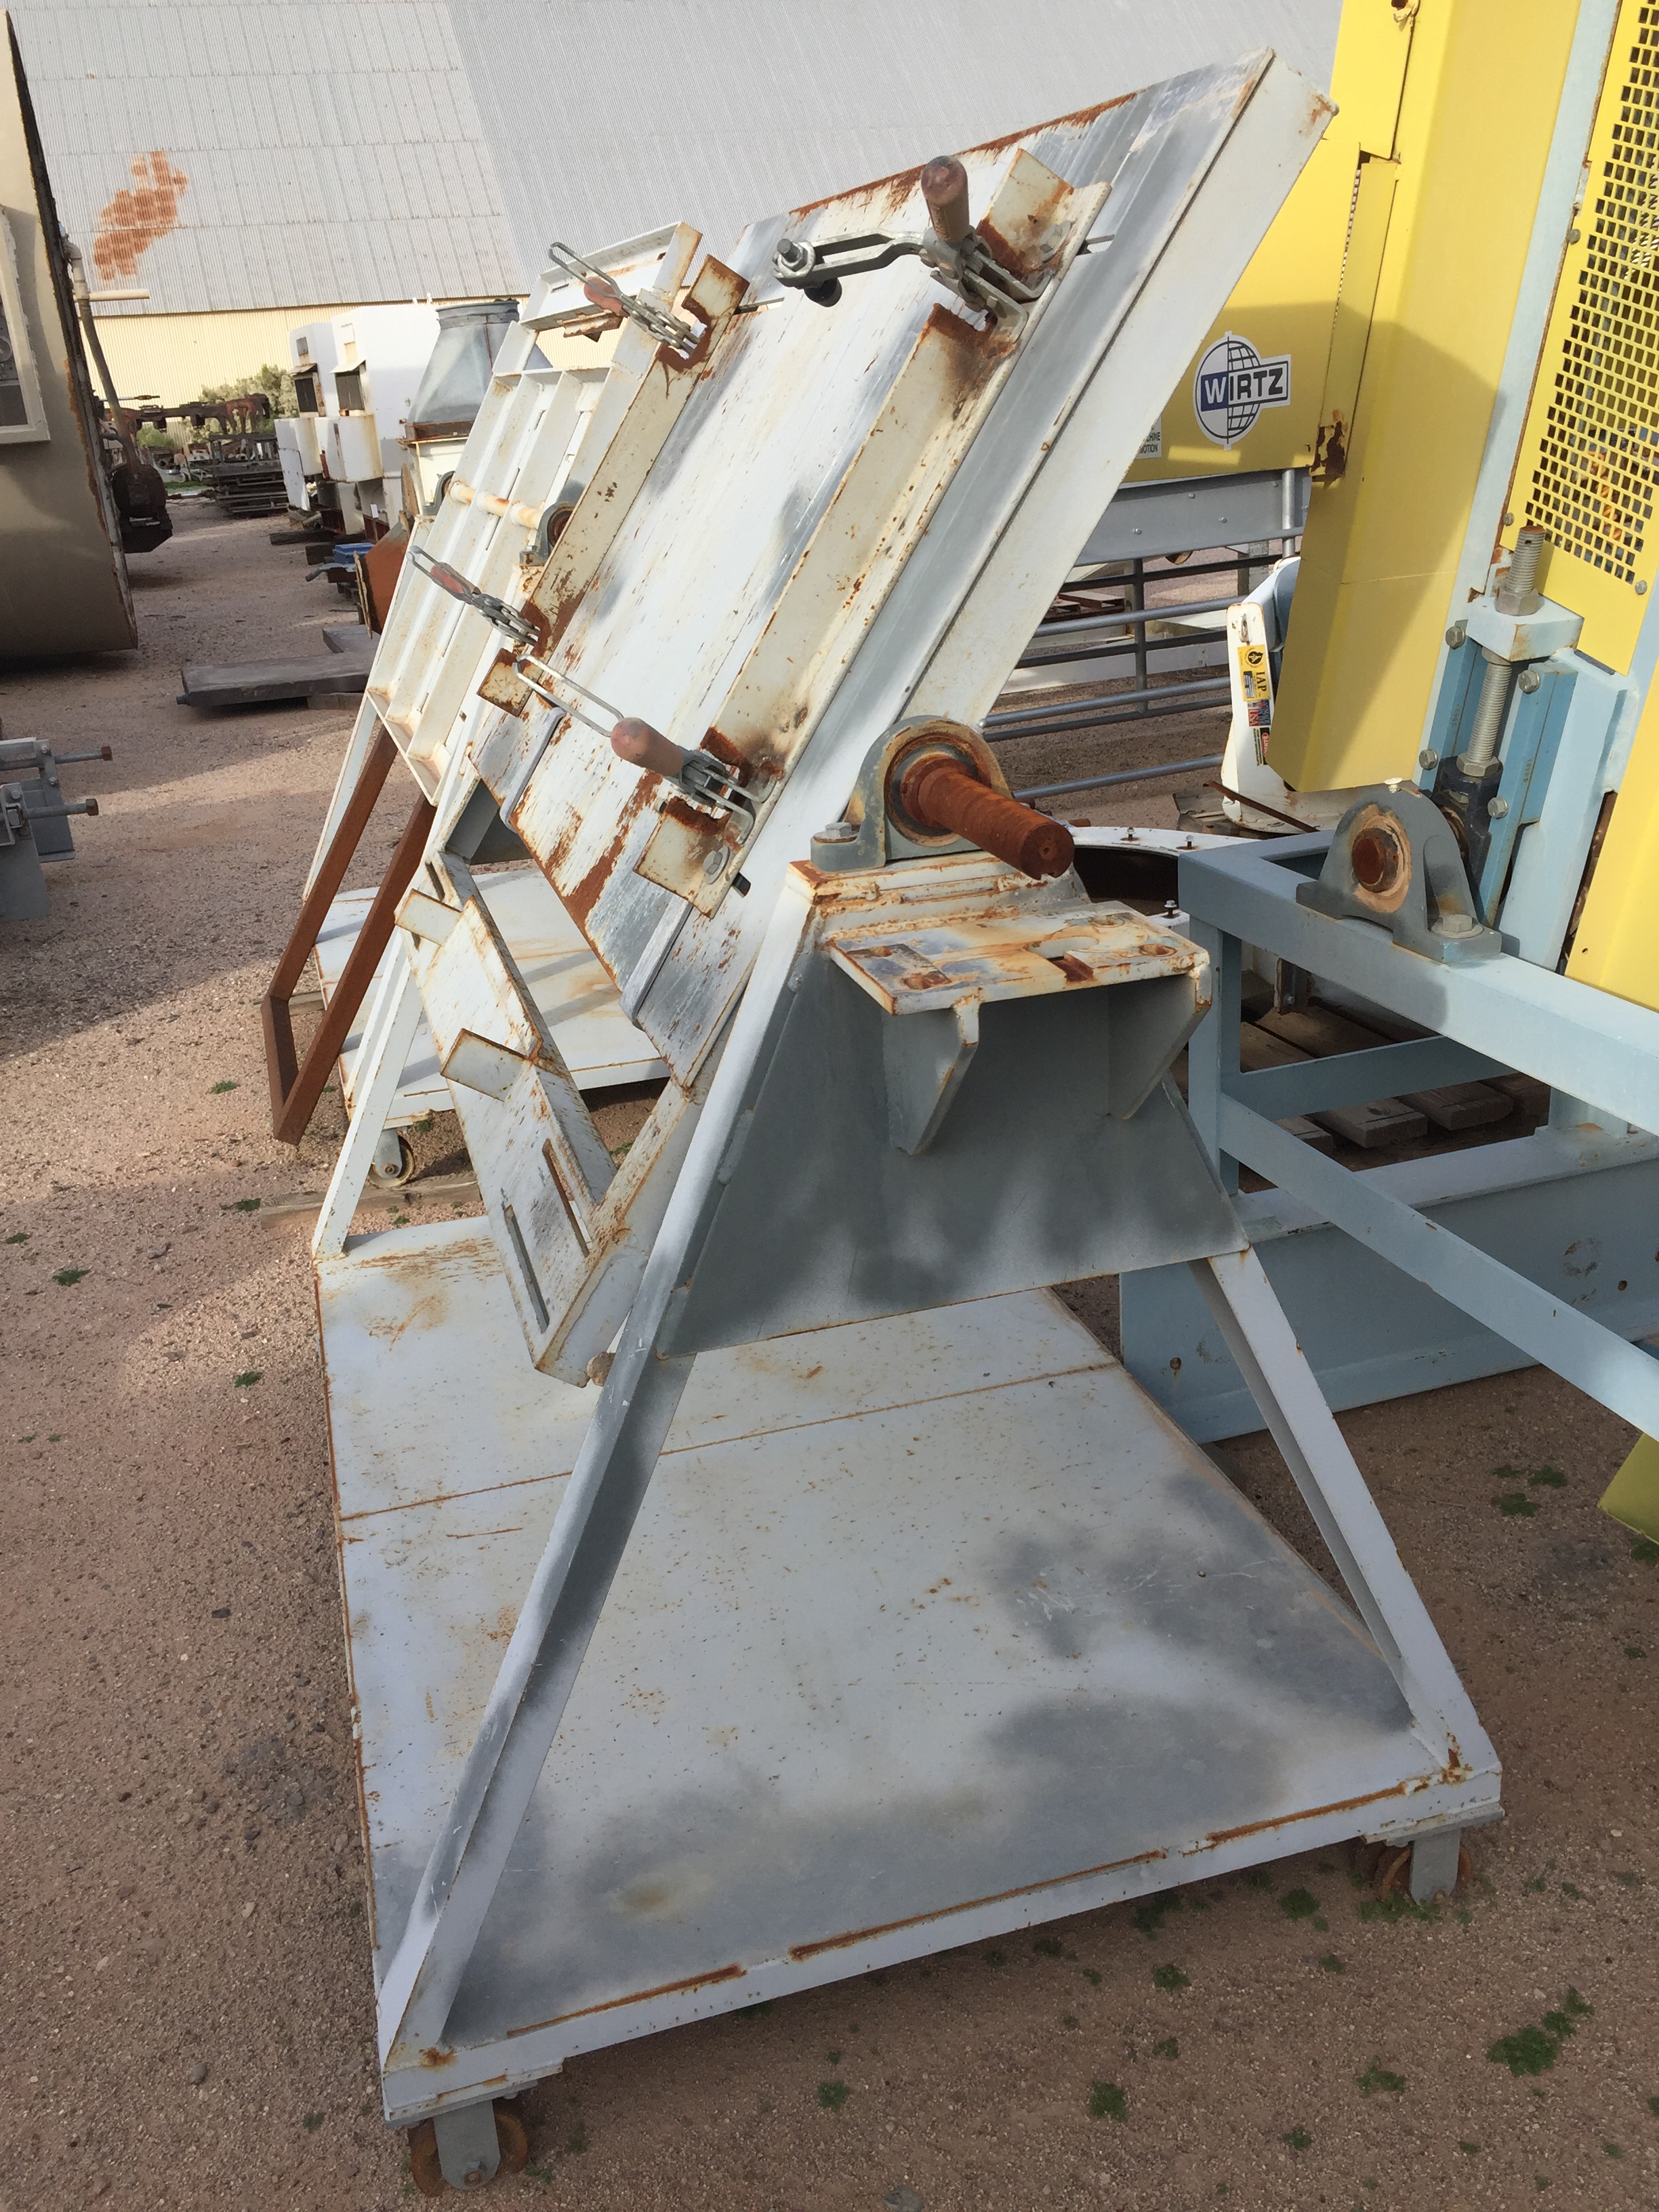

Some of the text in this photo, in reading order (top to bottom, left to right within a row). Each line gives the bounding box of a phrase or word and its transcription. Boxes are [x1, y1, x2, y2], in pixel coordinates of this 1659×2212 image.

[1204, 367, 1283, 404] WIRTZ
[1146, 432, 1161, 442] CHINE
[1256, 672, 1267, 692] IAP
[1249, 710, 1258, 726] USA
